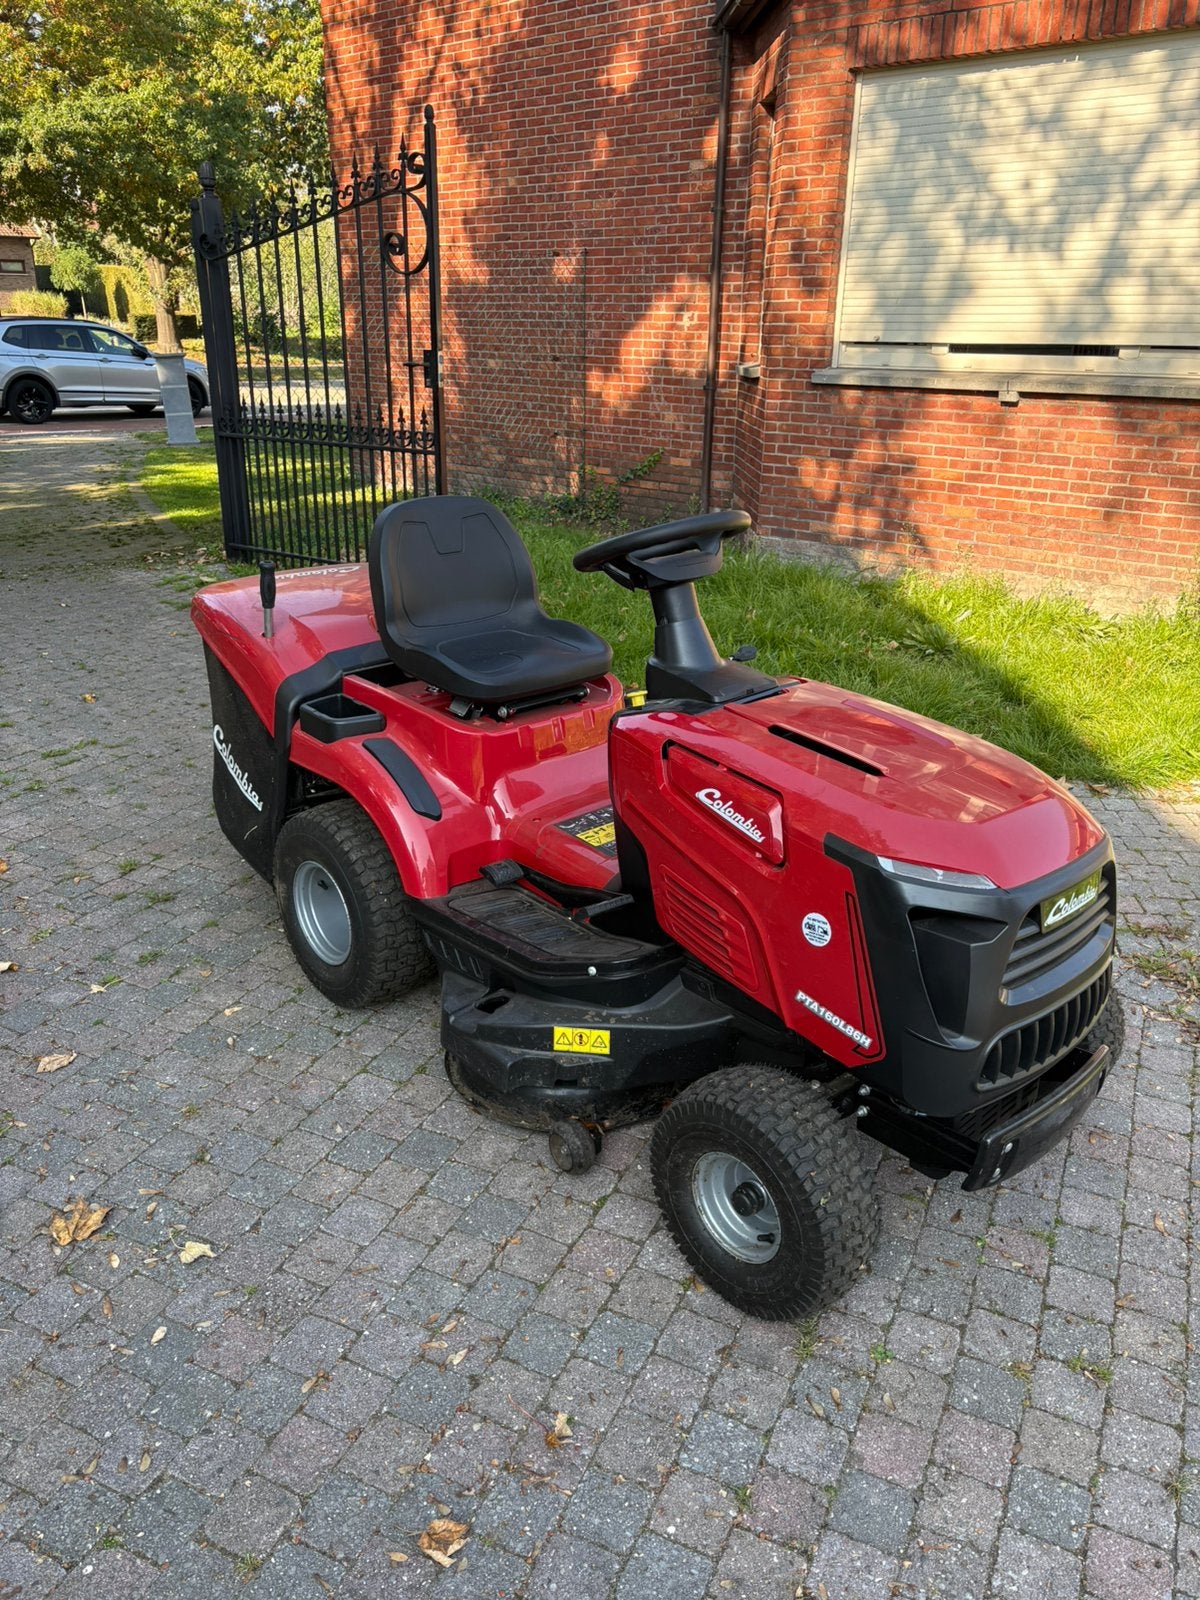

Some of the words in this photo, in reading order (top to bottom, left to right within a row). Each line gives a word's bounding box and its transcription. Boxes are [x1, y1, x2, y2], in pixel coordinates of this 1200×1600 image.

[213, 724, 263, 812] Colombia
[695, 788, 766, 843] Colombia
[795, 989, 873, 1050] PTA160L86H
